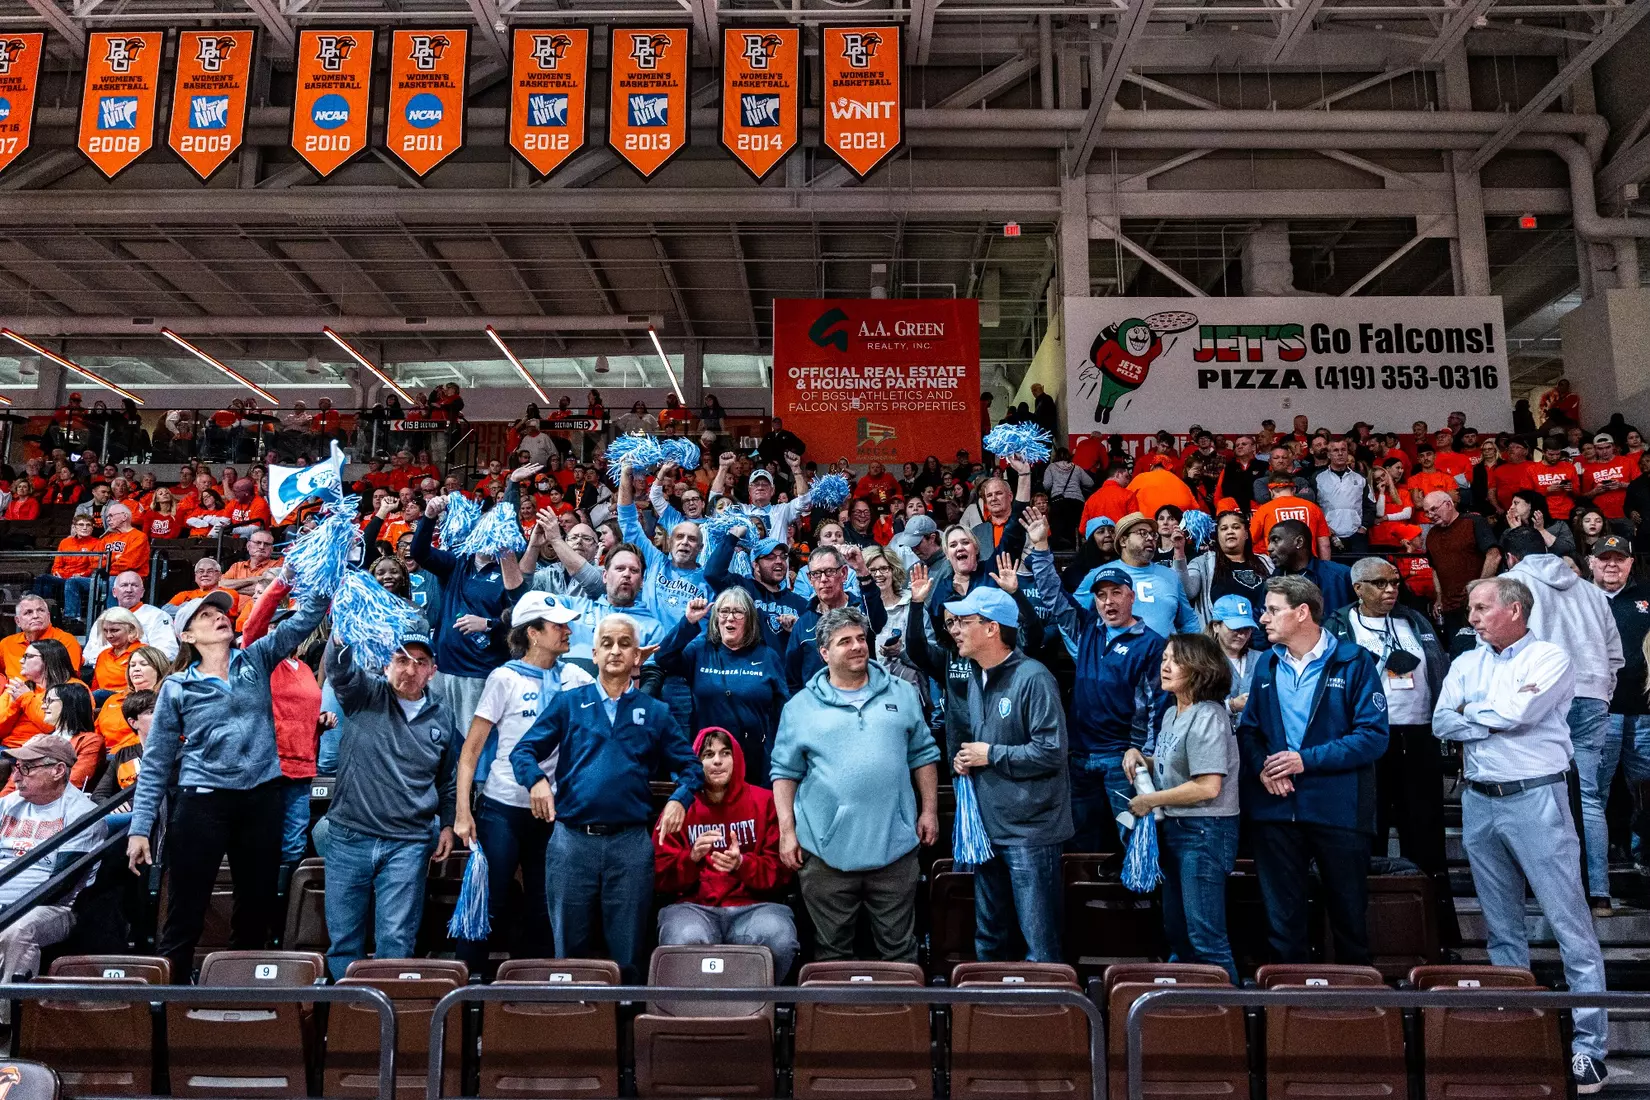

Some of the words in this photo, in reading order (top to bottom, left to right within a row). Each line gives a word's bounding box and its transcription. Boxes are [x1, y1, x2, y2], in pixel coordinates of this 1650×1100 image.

[107, 38, 130, 71] BG
[200, 38, 221, 71] BG
[319, 38, 340, 70] BG
[412, 37, 434, 69] BG
[534, 36, 556, 68] BG
[633, 36, 655, 68] BG
[746, 36, 767, 68] BG
[844, 34, 866, 67] BG
[0, 84, 28, 92] TBALL
[315, 111, 348, 121] NCAA
[409, 110, 442, 120] NCAA
[830, 98, 895, 119] WNIT
[89, 137, 140, 152] 2008
[180, 135, 231, 152] 2009
[305, 135, 350, 151] 2010
[403, 135, 443, 151] 2011
[524, 134, 569, 150] 2012
[625, 134, 671, 150] 2013
[738, 134, 782, 151] 2014
[840, 132, 886, 149] 2021
[858, 321, 890, 336] A.A.
[894, 320, 944, 336] GREEN
[1193, 324, 1308, 362] JET'S
[1310, 323, 1350, 354] Go
[1359, 323, 1495, 354] Falcons!
[788, 367, 860, 378] OFFICIAL
[864, 366, 905, 378] REAL
[909, 366, 966, 377] ESTATE
[1116, 367, 1139, 380] PIZZA
[1118, 359, 1142, 374] JET'S
[796, 378, 806, 390] &
[811, 378, 882, 390] HOUSING
[886, 378, 958, 389] PARTNER
[1198, 369, 1307, 389] PIZZA
[1315, 366, 1375, 389] (419)
[1381, 365, 1498, 390] 353-0316
[801, 391, 818, 401] OF
[822, 391, 855, 400] BGSU
[858, 390, 923, 400] ATHLETICS
[927, 390, 953, 399] AND
[788, 402, 838, 412] FALCON
[892, 402, 966, 411] PROPERTIES
[1538, 474, 1566, 482] BEAT
[1593, 466, 1623, 480] BEAT
[1280, 509, 1306, 520] ELITE
[658, 573, 705, 600] OLUMBIA
[1136, 581, 1154, 602] C
[1238, 602, 1247, 615] C
[632, 708, 646, 725] C
[262, 967, 270, 976] 9
[709, 960, 716, 970] 6
